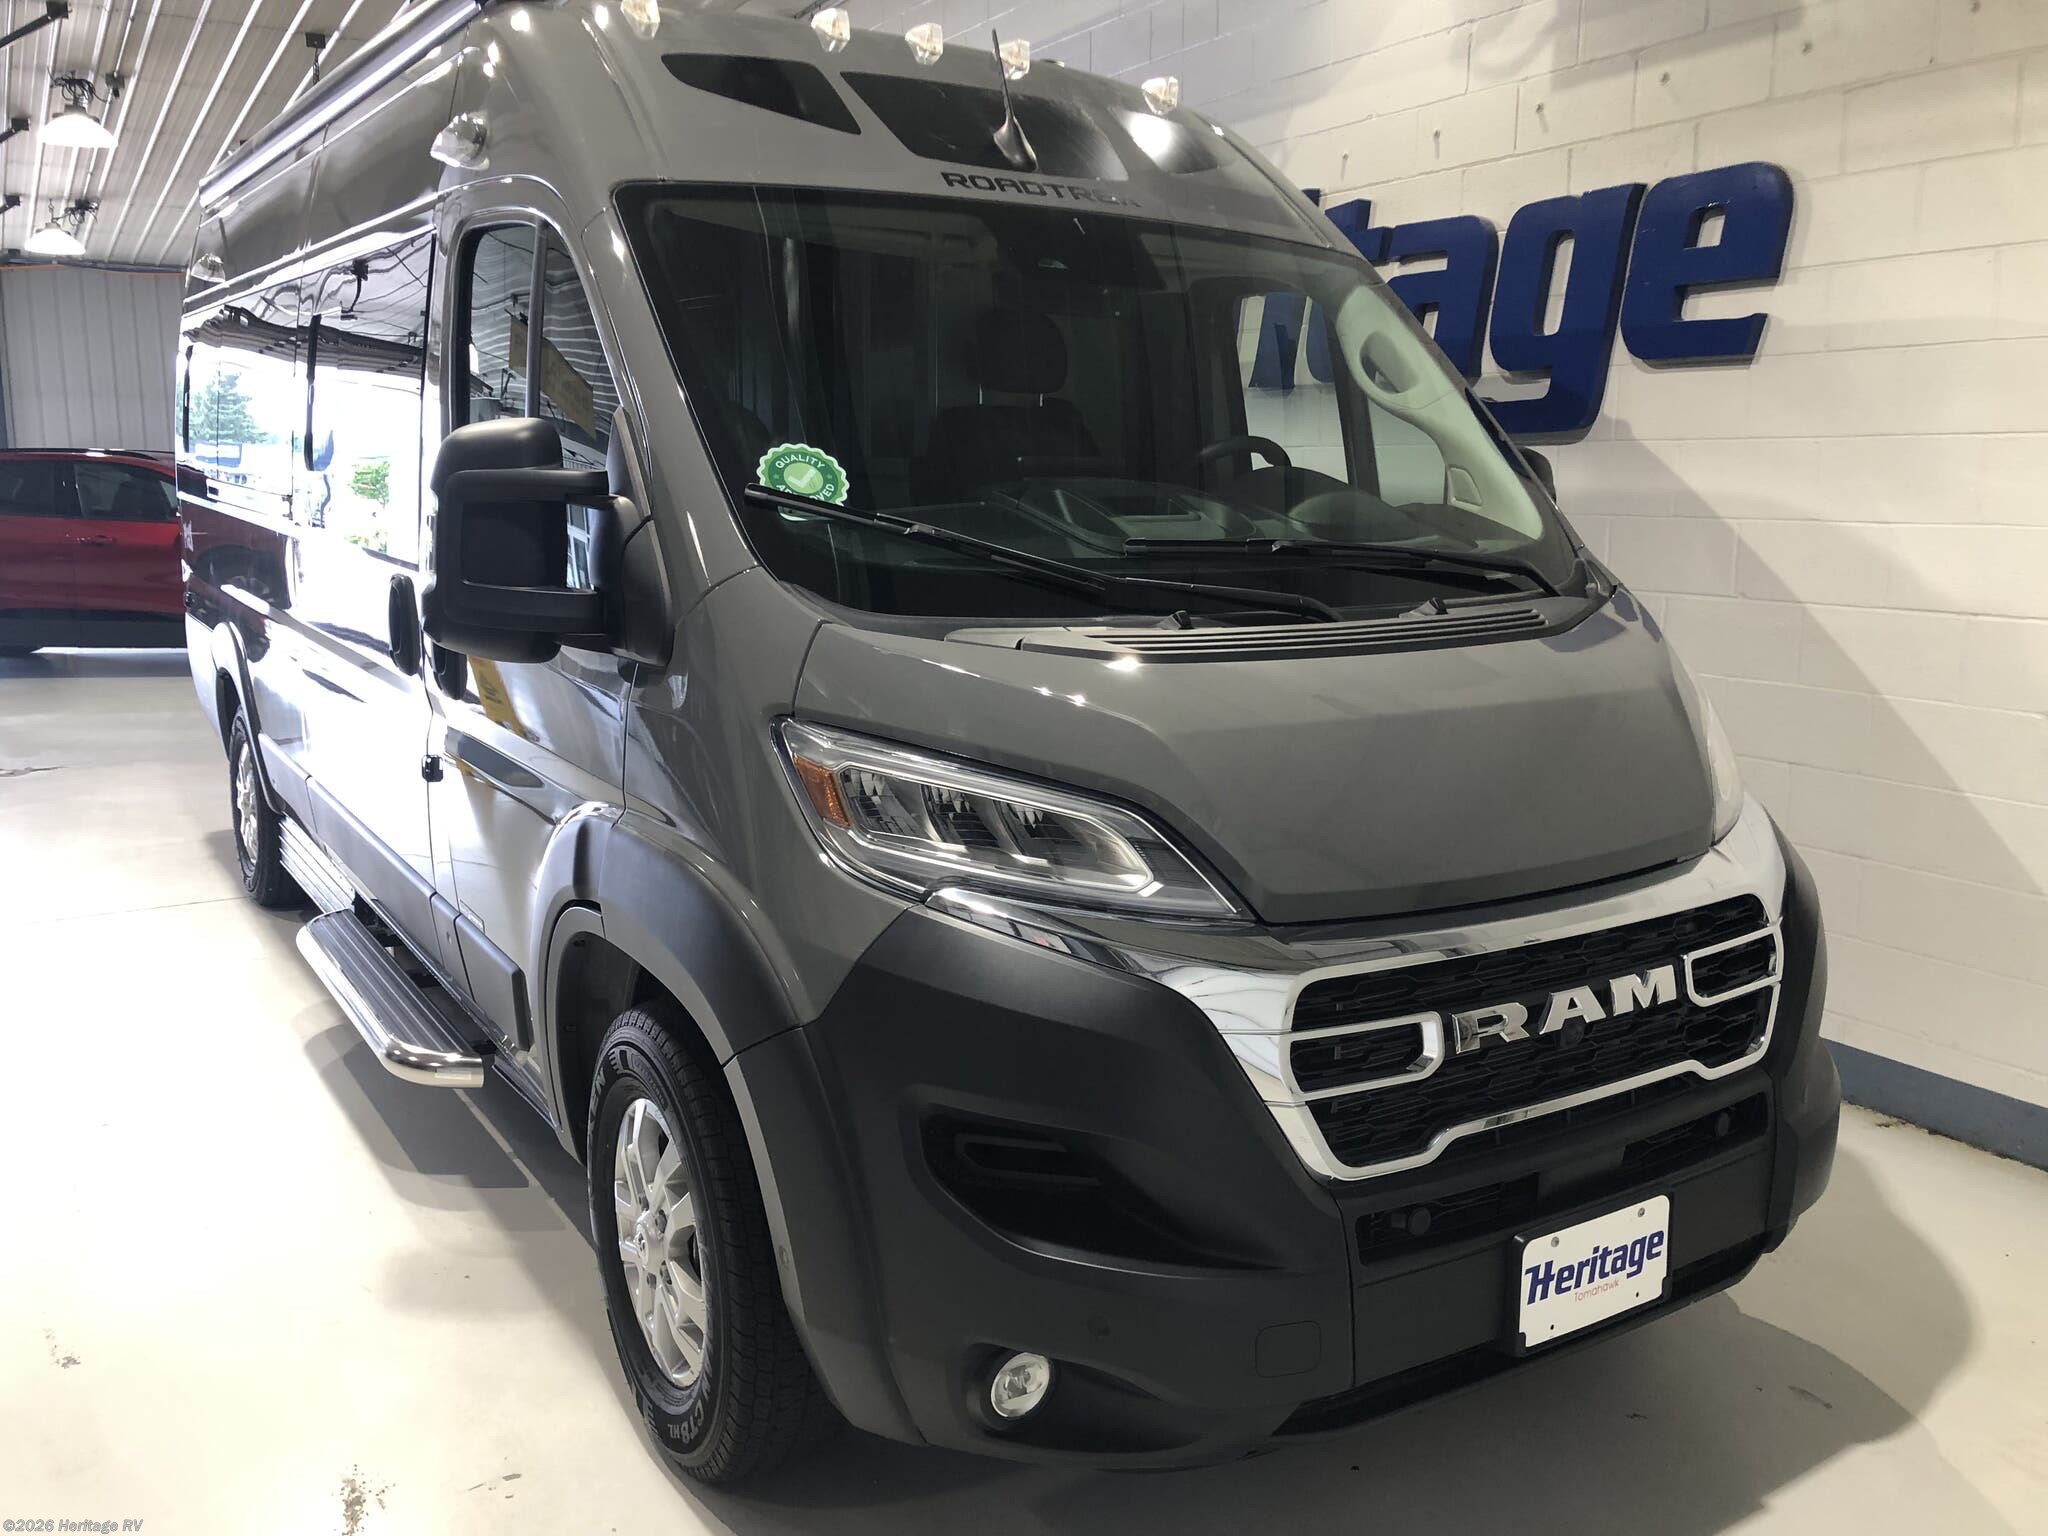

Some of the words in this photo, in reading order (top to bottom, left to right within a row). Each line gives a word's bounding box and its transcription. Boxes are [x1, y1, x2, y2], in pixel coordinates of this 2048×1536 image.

[775, 454, 825, 469] QUALITY
[776, 483, 835, 501] AVED
[1451, 965, 1677, 1055] RAM
[1524, 1230, 1665, 1306] Heritage
[1574, 1280, 1620, 1303] Tomahawk
